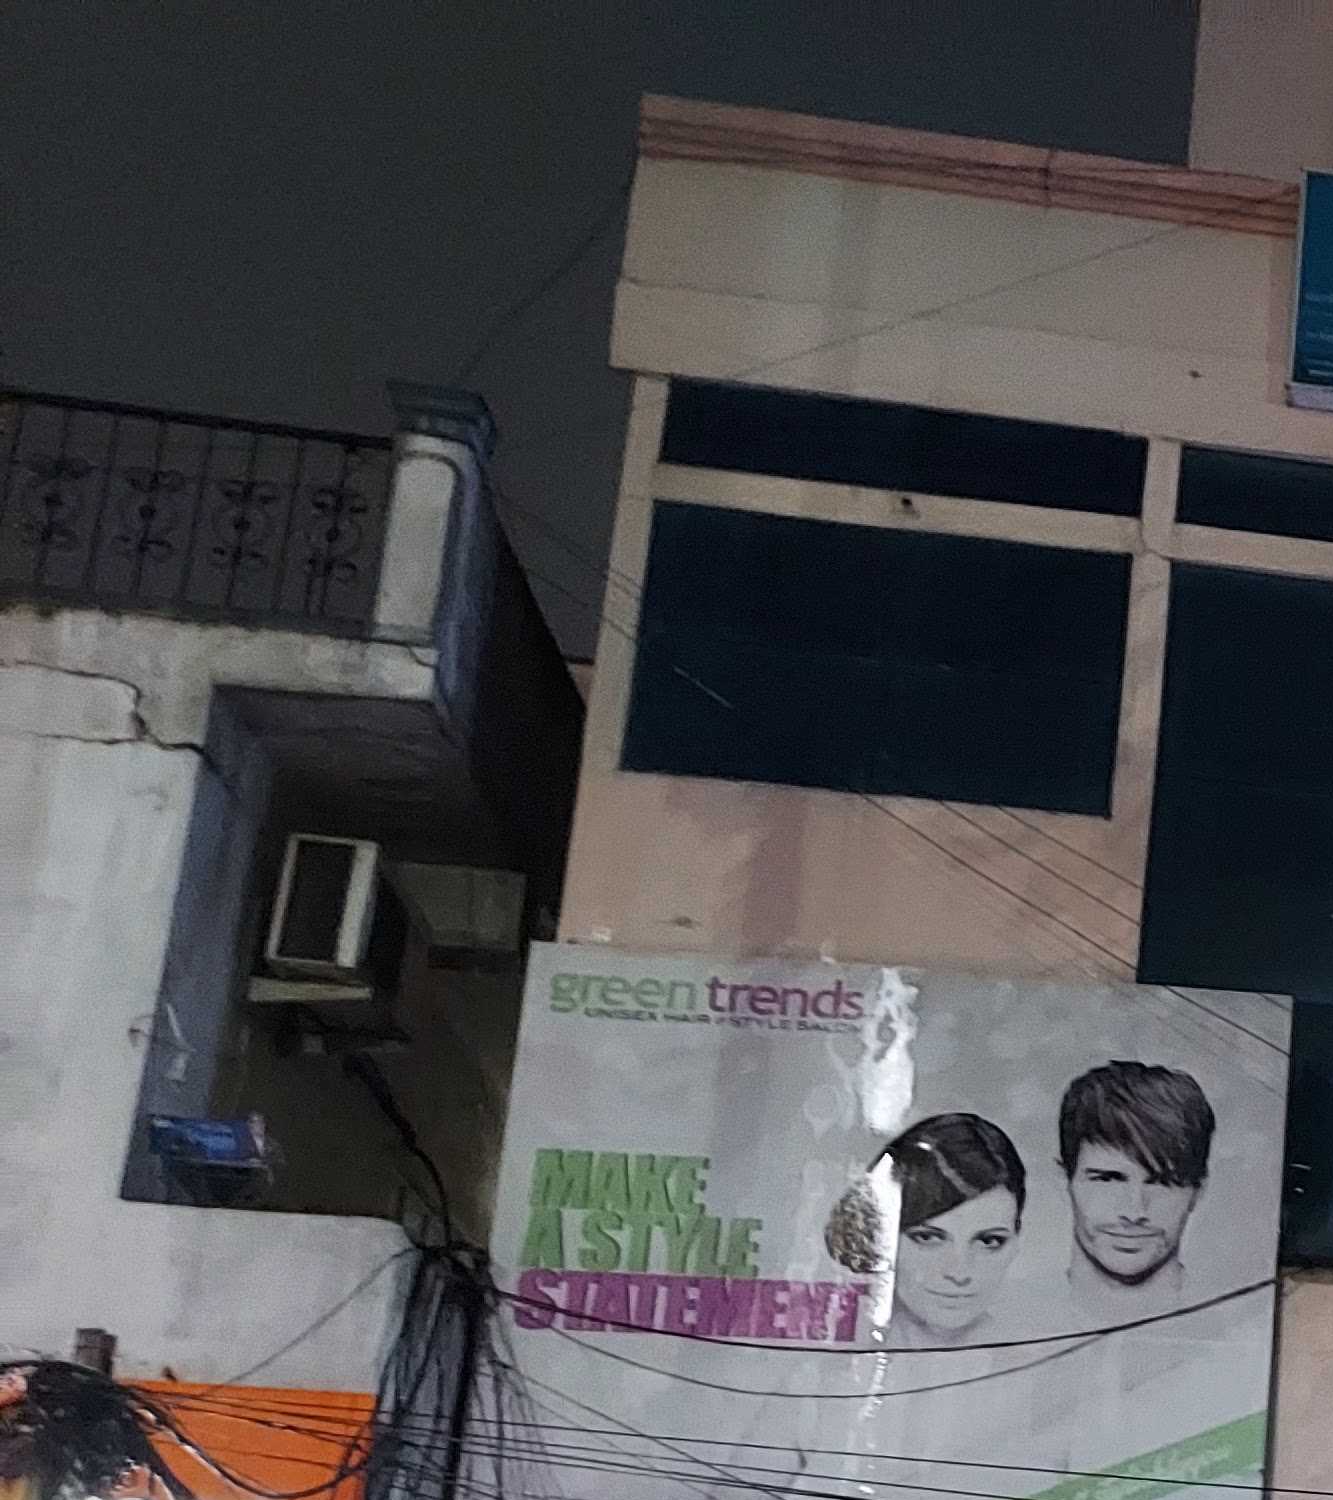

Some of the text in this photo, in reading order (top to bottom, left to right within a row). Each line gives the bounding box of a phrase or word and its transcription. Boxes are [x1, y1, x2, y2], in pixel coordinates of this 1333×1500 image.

[549, 972, 865, 1020] green trends
[529, 1148, 711, 1213] MAKE
[577, 1212, 764, 1278] STYLE
